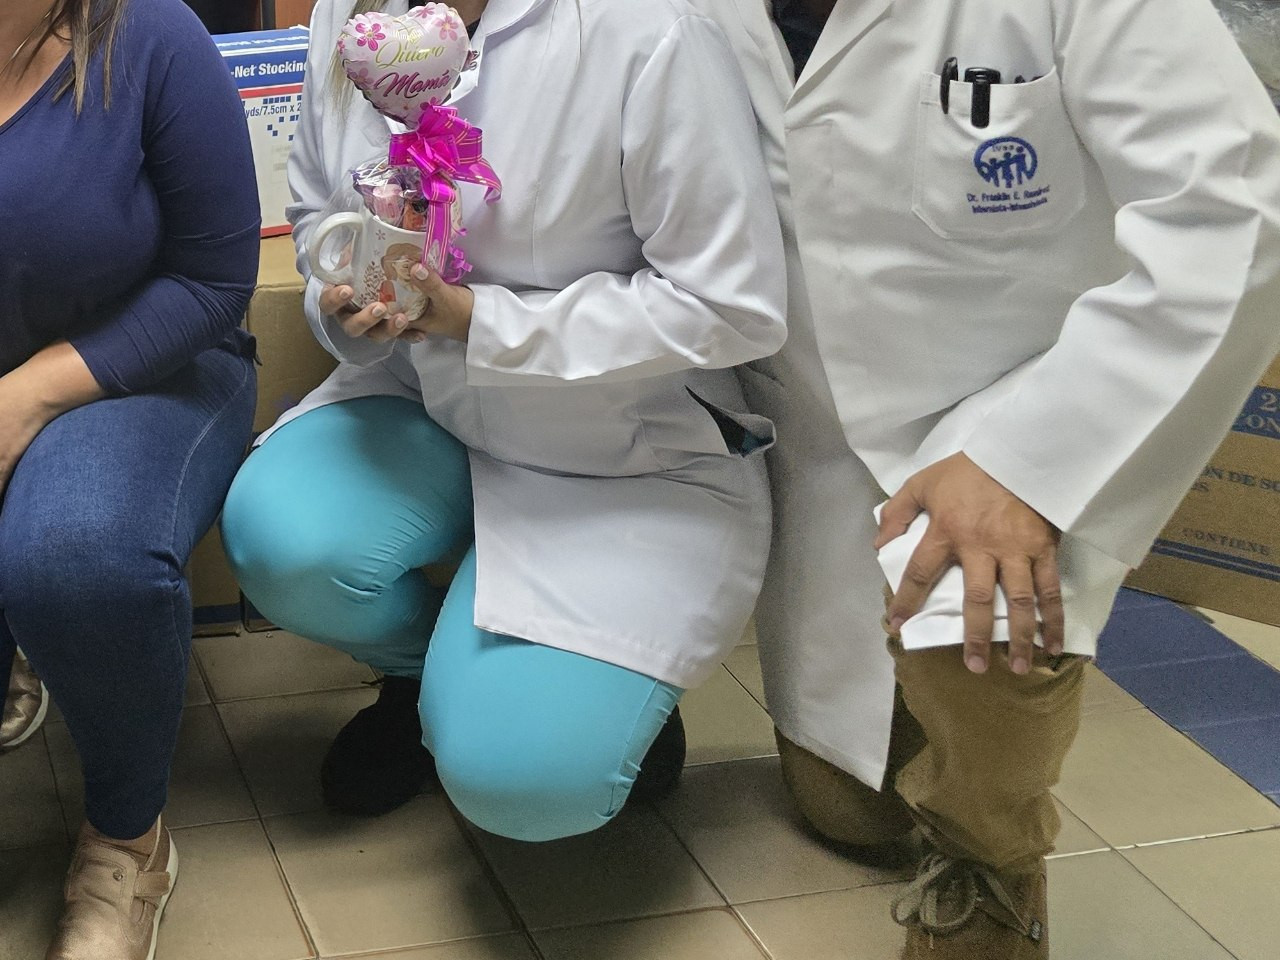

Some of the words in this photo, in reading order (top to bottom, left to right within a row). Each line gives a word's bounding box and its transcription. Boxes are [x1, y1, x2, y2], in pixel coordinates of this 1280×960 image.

[376, 41, 445, 68] Quiero
[374, 69, 451, 98] Mamá
[1229, 471, 1255, 488] DE
